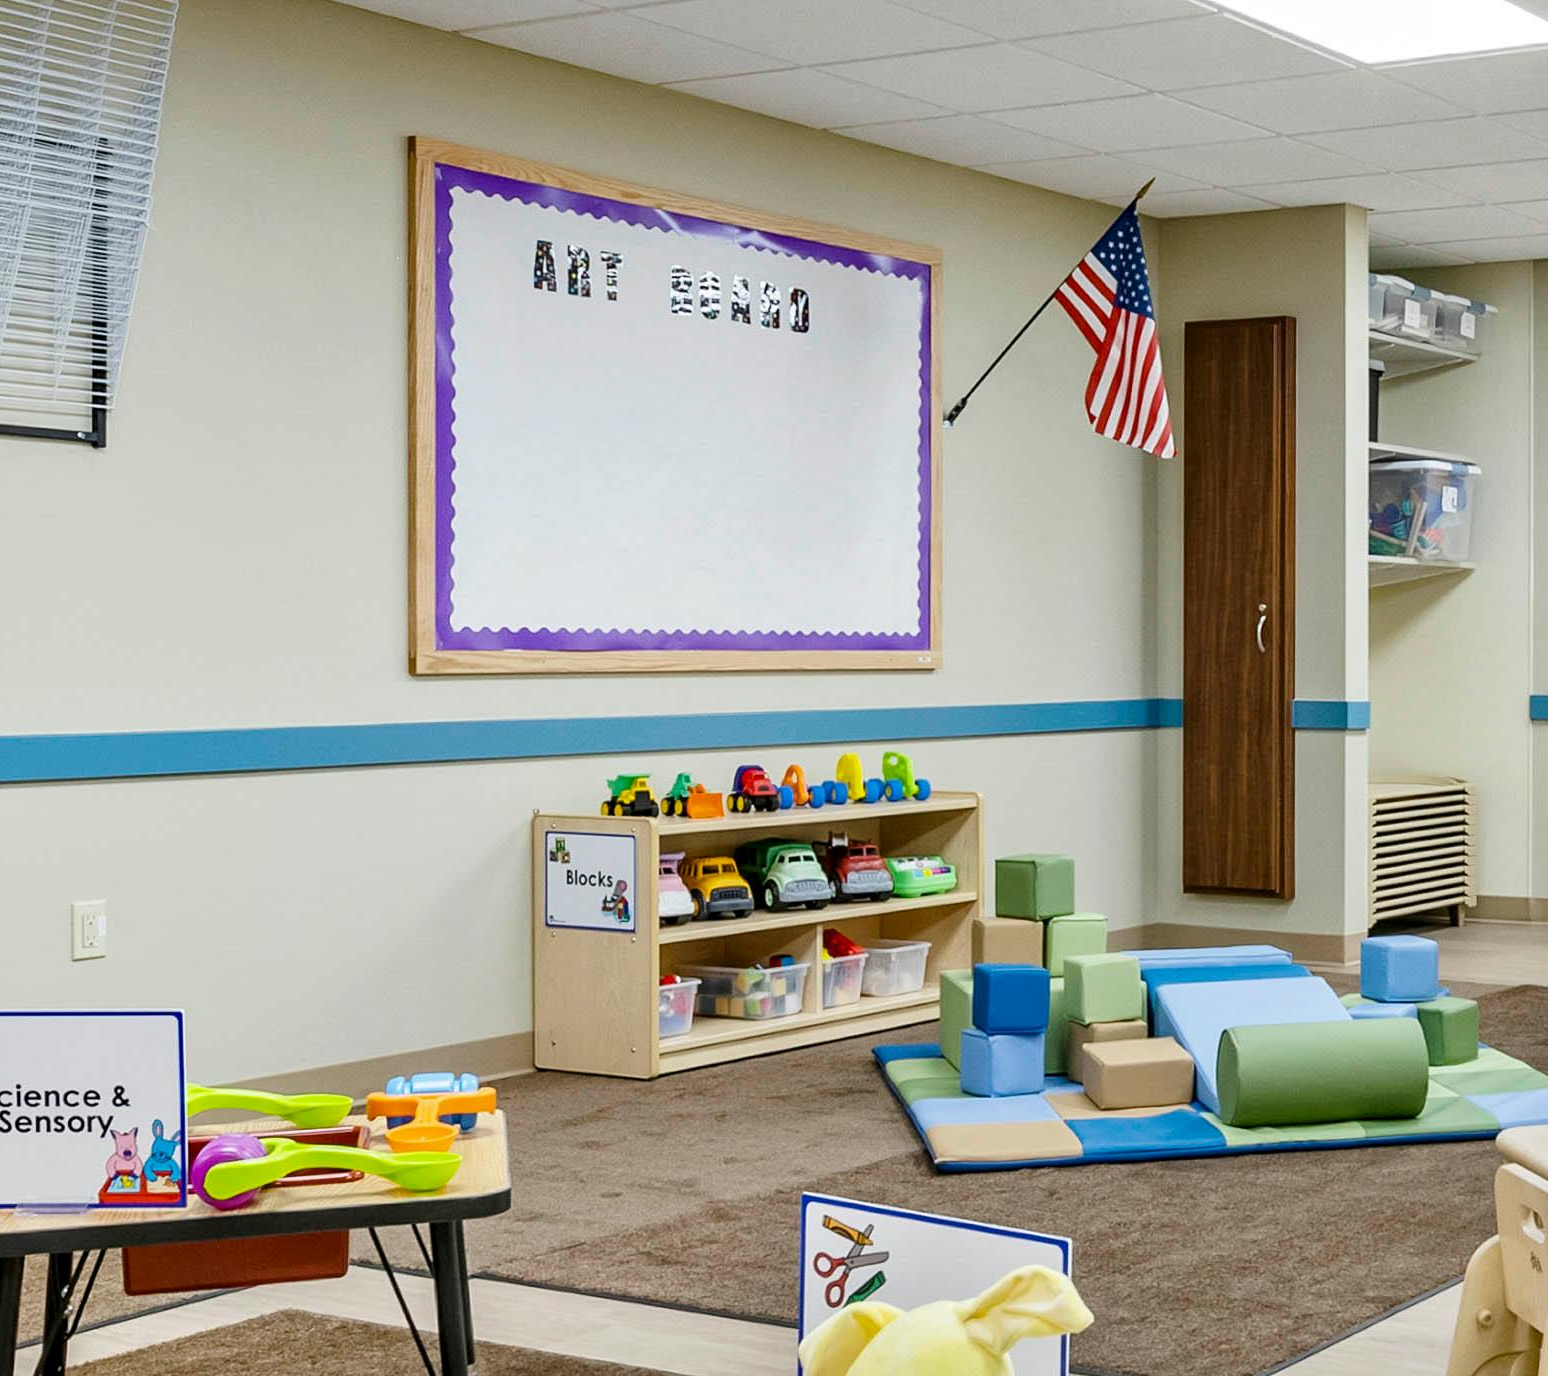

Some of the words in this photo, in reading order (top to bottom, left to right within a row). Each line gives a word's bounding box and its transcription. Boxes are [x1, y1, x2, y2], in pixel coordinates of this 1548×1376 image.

[533, 239, 624, 302] ART
[670, 264, 811, 334] BOARD
[565, 868, 614, 889] Blocks
[111, 1084, 131, 1110] &
